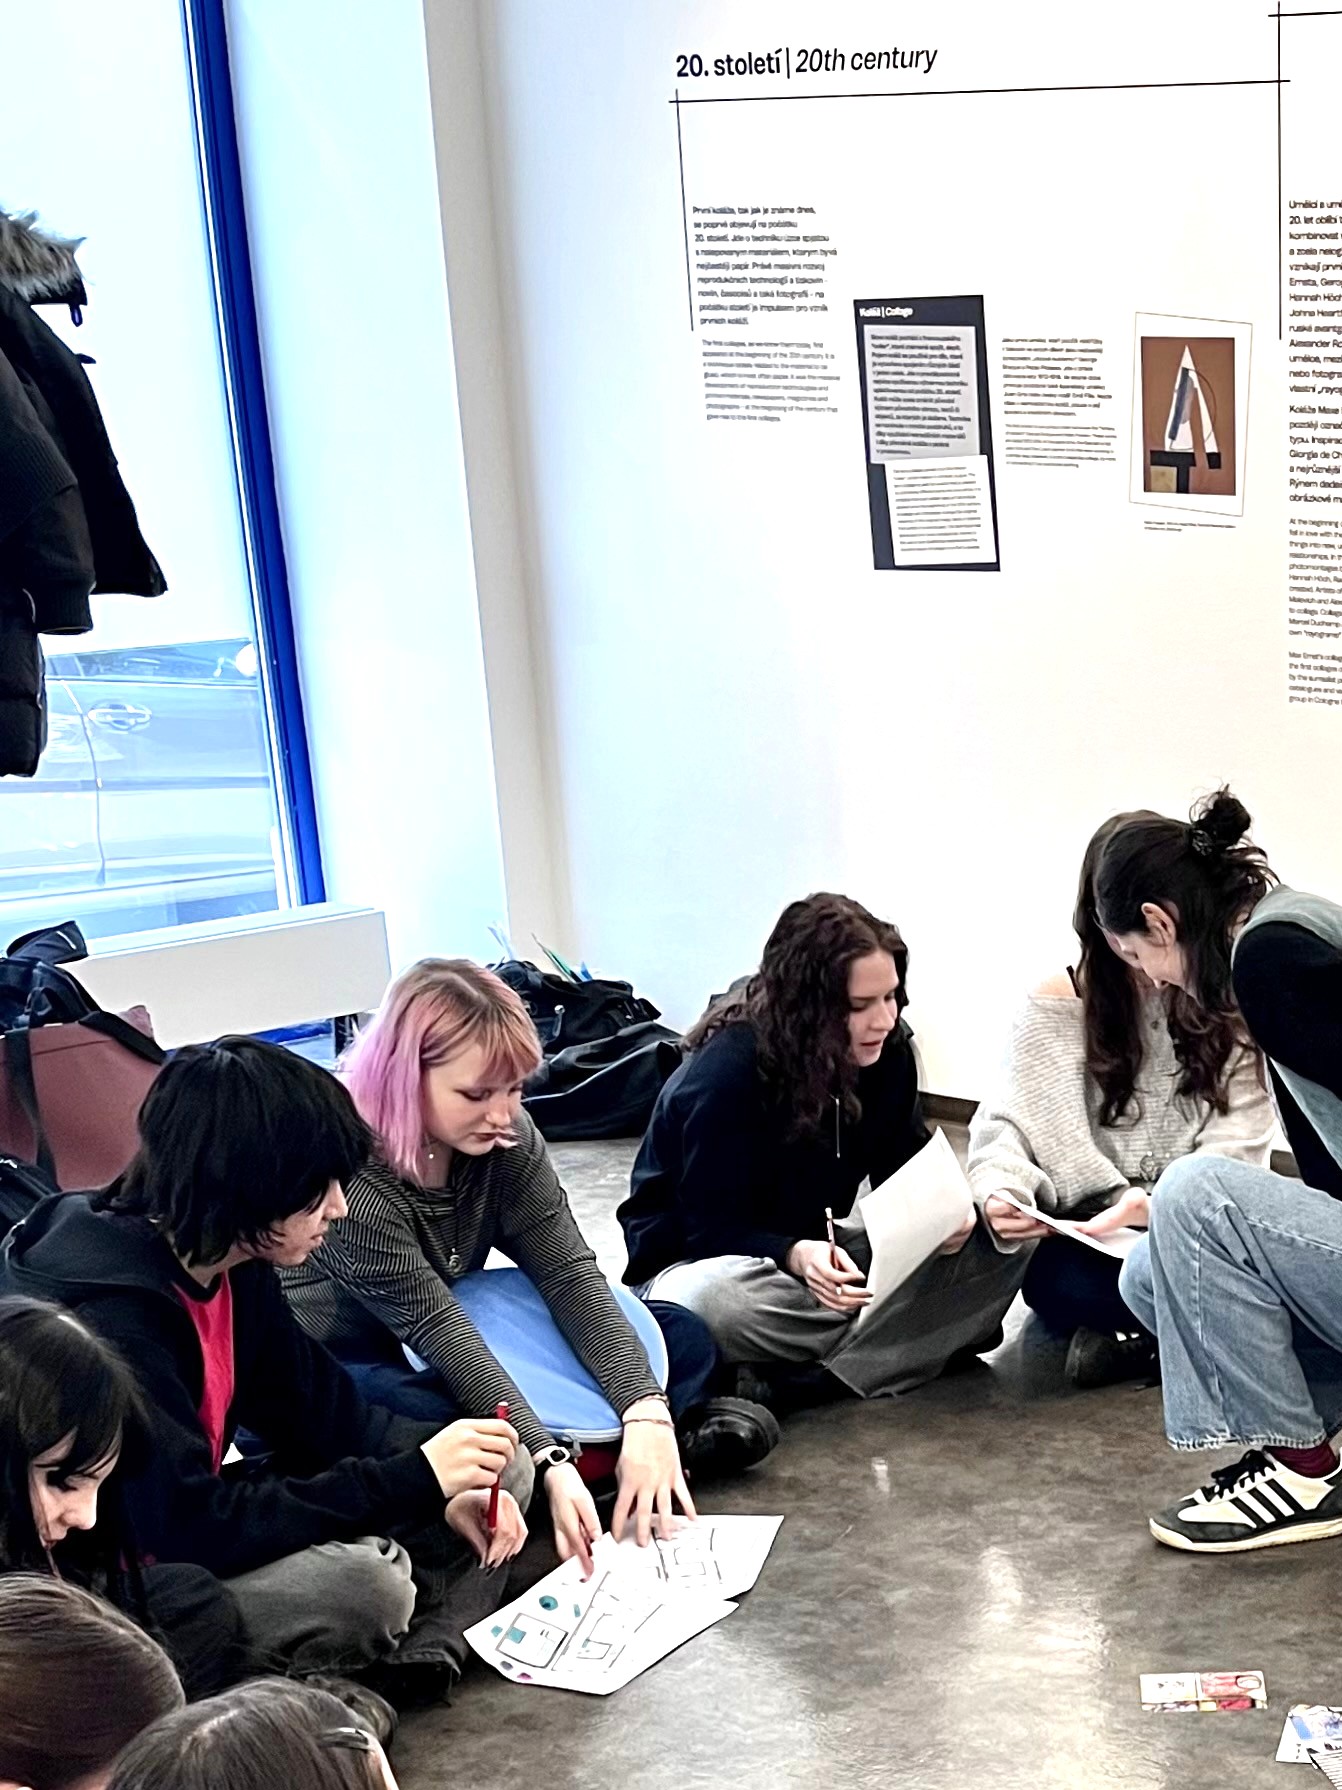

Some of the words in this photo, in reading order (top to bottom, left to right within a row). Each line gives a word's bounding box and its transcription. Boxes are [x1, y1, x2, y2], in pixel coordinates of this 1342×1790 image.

[675, 53, 709, 78] 20.
[714, 48, 782, 76] století
[795, 48, 845, 73] 20th
[850, 47, 938, 74] century
